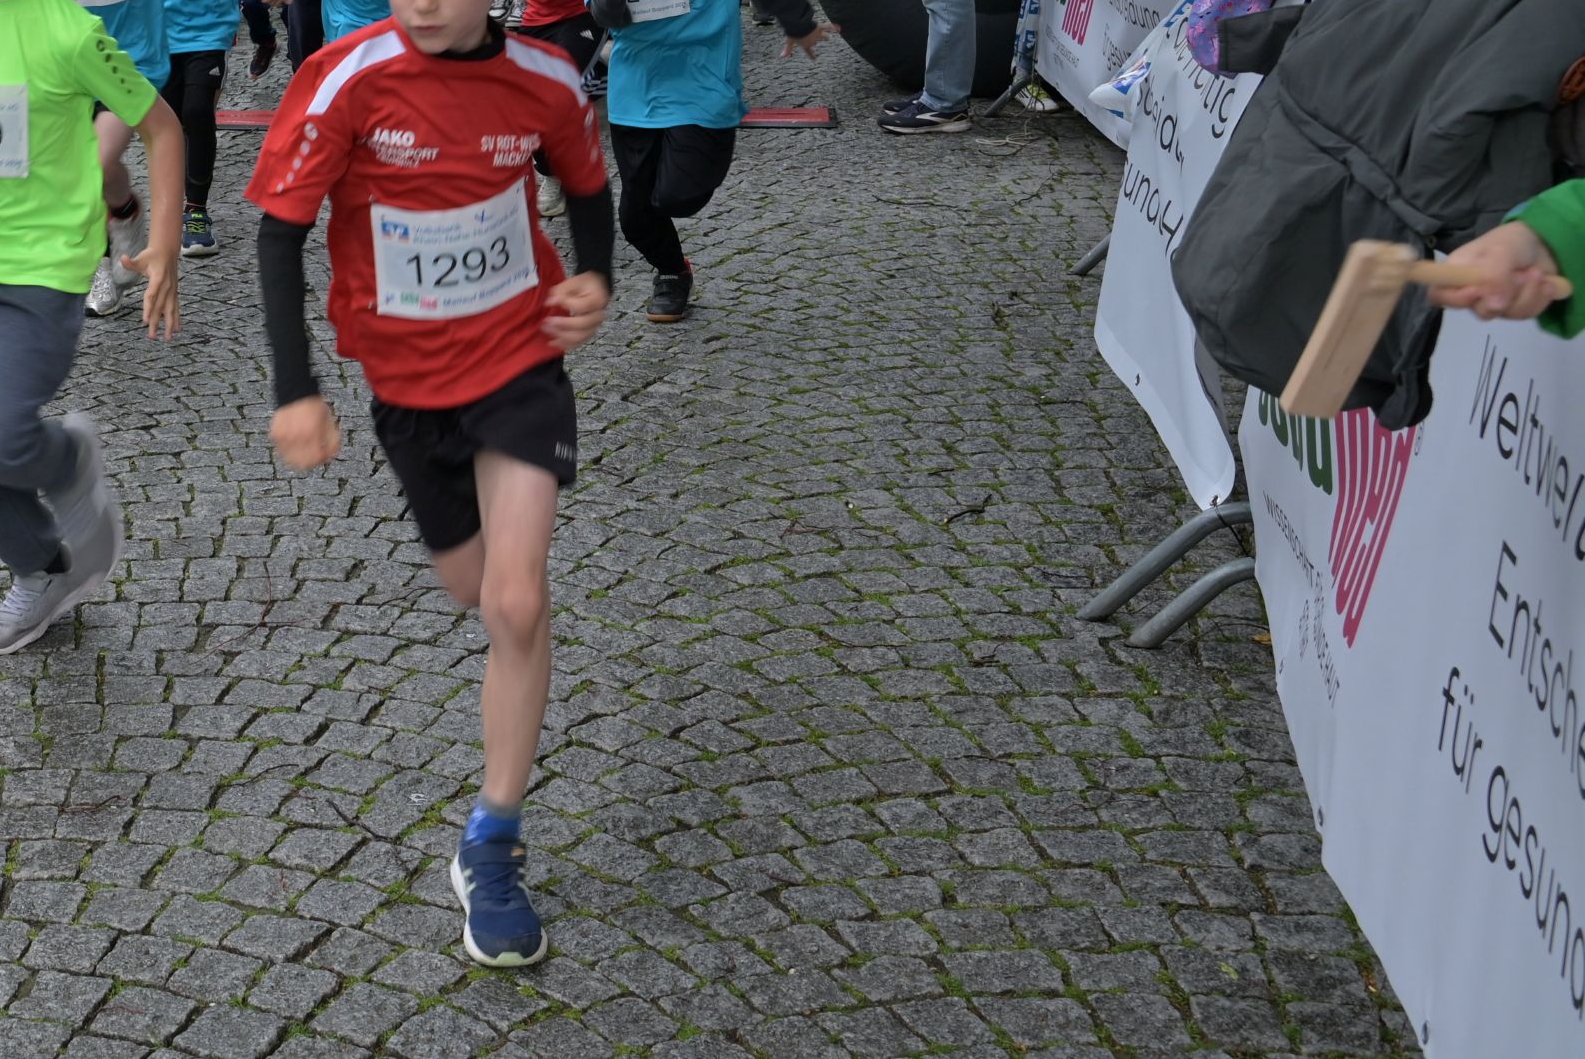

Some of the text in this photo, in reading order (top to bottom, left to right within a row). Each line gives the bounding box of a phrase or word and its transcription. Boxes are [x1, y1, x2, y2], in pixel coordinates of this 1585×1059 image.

[372, 126, 415, 148] JAKO
[481, 134, 496, 152] SV
[406, 236, 511, 288] 1293
[1438, 666, 1484, 795] für
